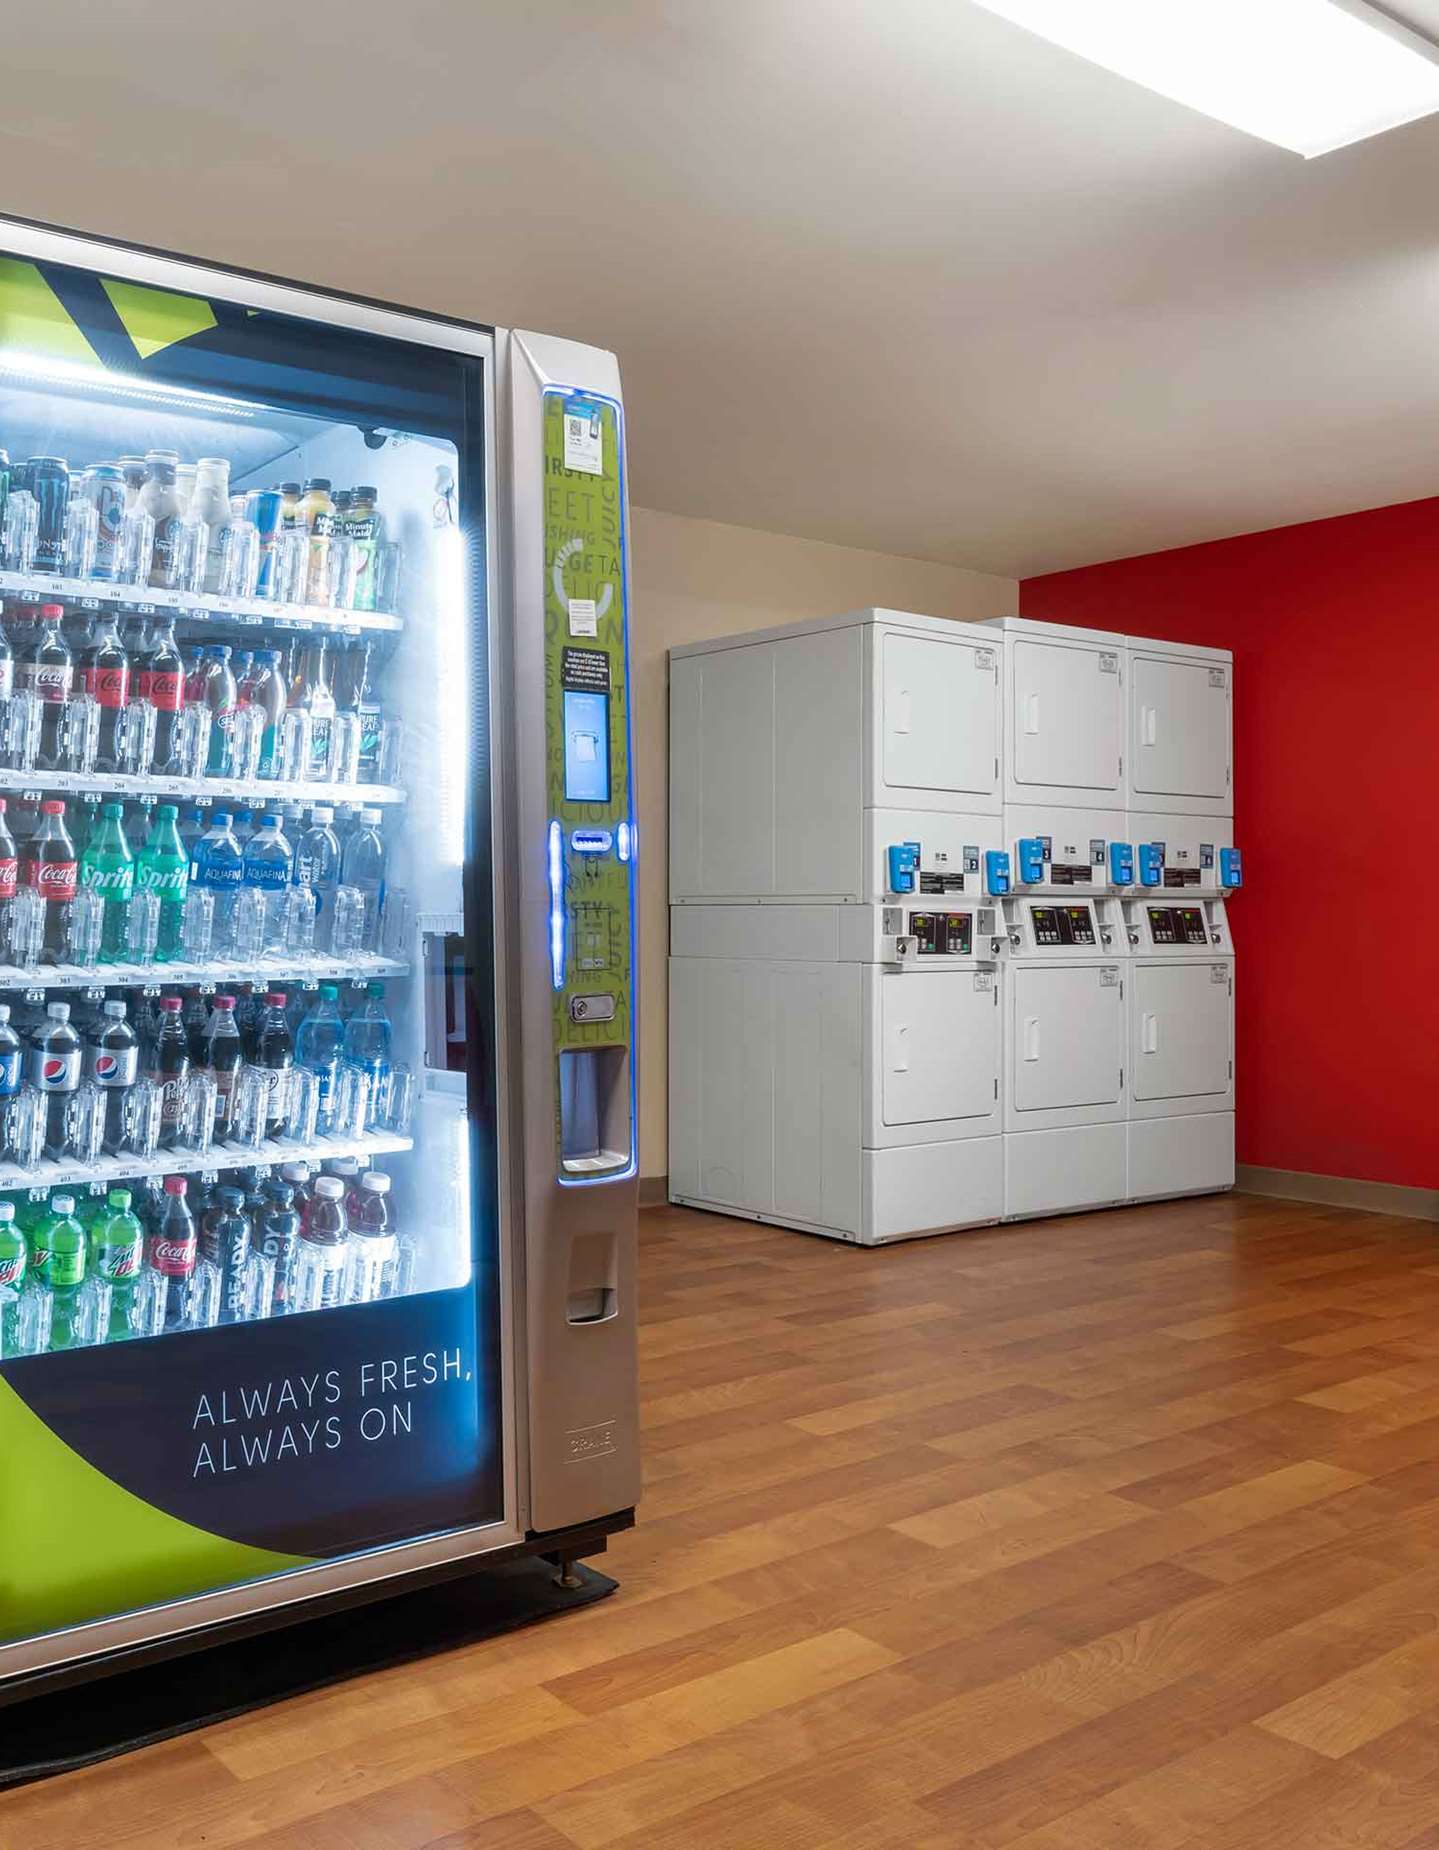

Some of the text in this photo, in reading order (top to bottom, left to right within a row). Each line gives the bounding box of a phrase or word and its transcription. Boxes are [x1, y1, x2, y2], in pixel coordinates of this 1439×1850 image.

[971, 861, 977, 869] 2
[192, 1348, 472, 1430] ALWAYS FRESH,
[193, 1402, 411, 1478] ALWAYS ON
